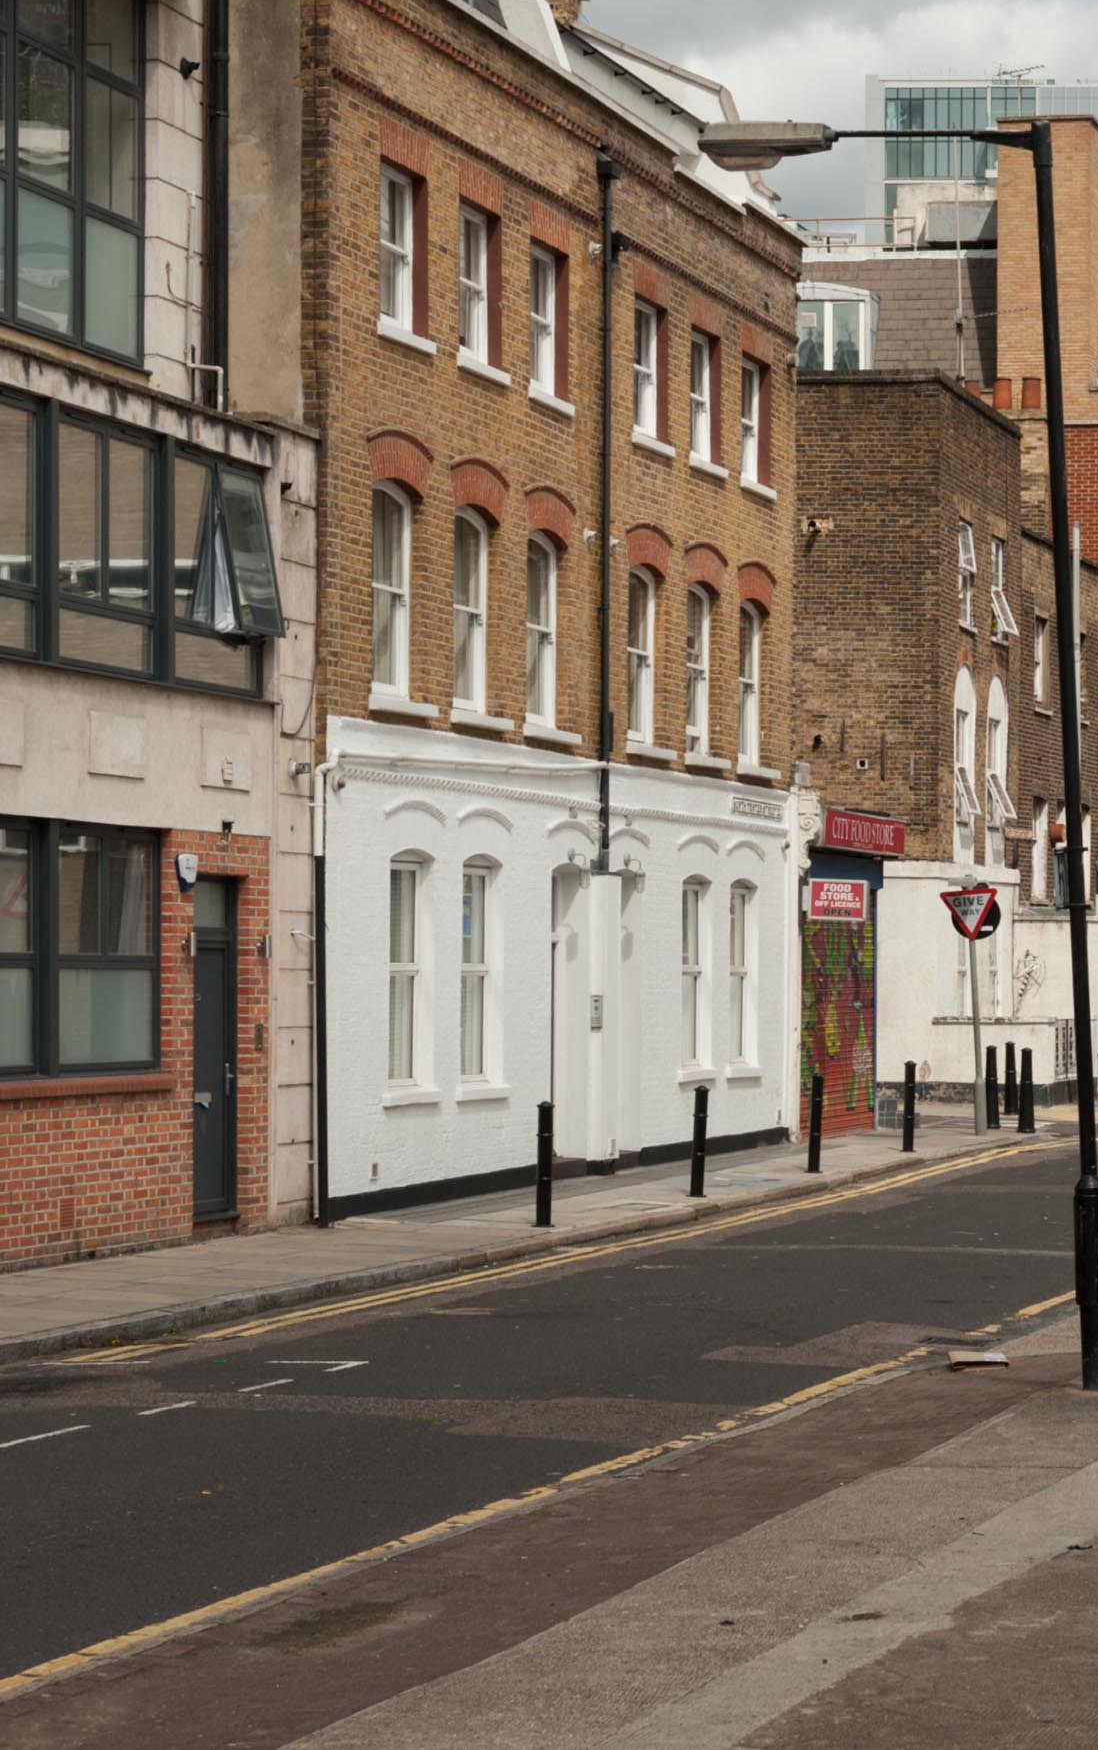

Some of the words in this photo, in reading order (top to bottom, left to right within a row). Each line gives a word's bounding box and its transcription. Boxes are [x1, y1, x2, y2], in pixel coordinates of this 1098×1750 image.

[832, 816, 850, 840] CITY
[850, 819, 872, 843] FOOD
[872, 823, 895, 846] STORE
[823, 883, 852, 892] FOOD
[952, 896, 984, 907] GIVE
[823, 908, 851, 916] OPEN
